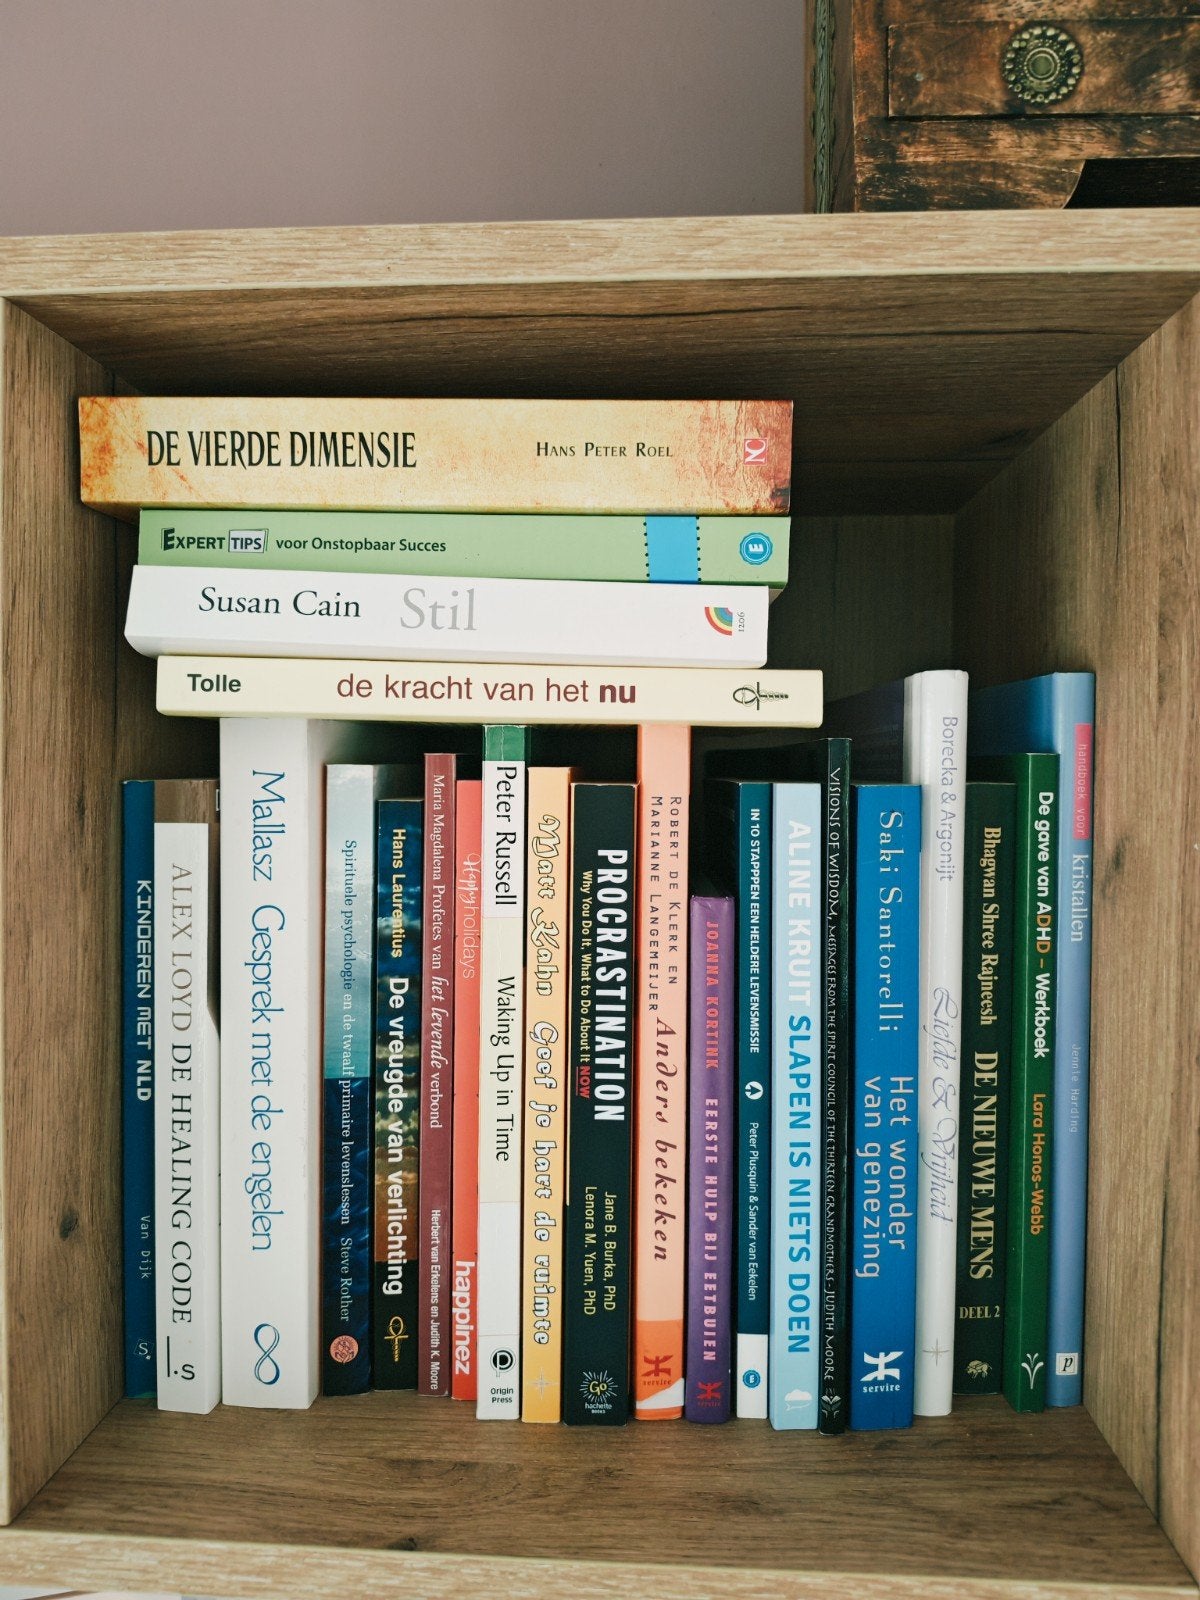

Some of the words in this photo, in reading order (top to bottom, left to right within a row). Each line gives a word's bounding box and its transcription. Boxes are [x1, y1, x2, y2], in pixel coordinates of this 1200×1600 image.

[146, 430, 181, 467] DE
[187, 430, 281, 470] VIERDE
[289, 431, 418, 469] DIMENSIE
[162, 527, 225, 552] EXPERT
[230, 535, 262, 551] TIPS
[275, 538, 308, 550] voor
[311, 536, 396, 554] Onstopbaar
[399, 538, 447, 552] Succes
[198, 586, 281, 615] Susan
[292, 590, 361, 618] Cain
[400, 587, 478, 632] Stil
[186, 673, 242, 693] Tolle
[336, 673, 373, 698] de
[384, 673, 473, 700] kracht
[482, 680, 535, 702] van
[545, 677, 589, 703] het
[599, 684, 636, 704] nu
[940, 716, 959, 786] Borecka
[432, 774, 445, 810] Maria
[495, 765, 518, 823] Peter
[828, 767, 842, 828] VISIONS
[941, 791, 957, 805] &
[1038, 791, 1054, 816] De
[252, 769, 286, 882] Mallasz
[750, 808, 761, 822] IN
[750, 823, 761, 838] 10
[392, 828, 407, 869] Hans
[430, 813, 445, 880] Magdalena
[531, 814, 561, 900] Matt
[829, 831, 840, 849] OF
[878, 810, 904, 873] Saki
[935, 809, 956, 882] Argonijt
[980, 826, 1002, 898] Bhagwan
[1034, 819, 1051, 862] gave
[343, 839, 358, 907] Spirituele
[494, 831, 517, 906] Russell
[581, 870, 594, 894] Why
[749, 839, 761, 900] STAPPPEN
[788, 820, 811, 909] ALINE
[826, 852, 841, 921] WISDOM,
[1037, 865, 1050, 897] van
[172, 863, 193, 940] ALEX
[391, 873, 406, 958] Laurentius
[432, 884, 445, 941] Profetes
[580, 896, 593, 917] You
[749, 902, 760, 924] EEN
[1070, 853, 1088, 942] kristallen
[137, 880, 152, 999] KINDEREN
[580, 920, 593, 936] Do
[580, 937, 593, 950] It,
[982, 902, 1000, 949] Shree
[1036, 901, 1052, 954] ADHD
[244, 904, 285, 1024] Gesprek
[340, 909, 356, 990] psychologie
[431, 944, 442, 970] van
[530, 907, 560, 997] Kahn
[580, 952, 592, 982] What
[705, 921, 719, 987] JOANNA
[749, 925, 760, 974] HELDERE
[787, 919, 811, 1007] KRUIT
[878, 886, 904, 1034] Santorelli
[171, 951, 193, 1032] LOYD
[343, 993, 352, 1010] en
[388, 977, 409, 1009] De
[431, 975, 449, 1001] het
[580, 983, 592, 997] to
[580, 999, 592, 1015] Do
[593, 849, 629, 1122] PROCRASTINATION
[976, 953, 999, 1026] Rajneesh
[137, 1007, 151, 1050] MET
[342, 1013, 355, 1031] de
[490, 975, 516, 1047] Waking
[705, 996, 719, 1069] KORTINK
[749, 976, 760, 1054] LEVENSMISSIE
[1033, 972, 1051, 1059] Werkboek
[342, 1034, 356, 1078] twaalf
[427, 1007, 446, 1068] levende
[530, 1021, 562, 1090] Geef
[579, 1017, 592, 1052] About
[172, 1043, 193, 1082] DE
[252, 1032, 274, 1086] met
[382, 1015, 406, 1114] vreugde
[490, 1054, 515, 1083] Up
[579, 1053, 592, 1063] It
[655, 1016, 679, 1124] Anders
[789, 1014, 812, 1129] SLAPEN
[975, 1050, 1001, 1088] DE
[136, 1059, 152, 1102] NLD
[430, 1072, 442, 1129] verbond
[496, 1089, 514, 1107] in
[864, 1075, 883, 1128] van
[889, 1075, 914, 1127] Het
[251, 1094, 284, 1131] de
[339, 1079, 354, 1138] primaire
[529, 1100, 557, 1128] je
[1032, 1093, 1047, 1128] Lara
[387, 1120, 405, 1163] van
[495, 1114, 513, 1162] Time
[704, 1098, 719, 1165] EERSTE
[749, 1122, 760, 1150] Peter
[971, 1094, 998, 1198] NIEUWE
[171, 1092, 193, 1230] HEALING
[532, 1140, 558, 1199] hart
[746, 1151, 760, 1194] Plusquin
[788, 1141, 811, 1168] IS
[244, 1142, 284, 1251] engelen
[340, 1140, 354, 1225] levenslessen
[653, 1139, 678, 1262] bekeken
[704, 1175, 718, 1222] HULP
[748, 1195, 759, 1204] &
[888, 1138, 914, 1251] wonder
[1030, 1133, 1046, 1236] Honos-Webb
[140, 1214, 151, 1239] Van
[430, 1209, 441, 1244] Herbert
[534, 1210, 557, 1242] de
[583, 1185, 597, 1230] Lenora
[603, 1191, 617, 1222] Jane
[747, 1204, 759, 1240] Sander
[787, 1178, 811, 1262] NIETS
[854, 1142, 886, 1278] genezing
[382, 1169, 408, 1296] verlichting
[584, 1232, 597, 1249] M.
[603, 1224, 617, 1238] B.
[704, 1232, 718, 1262] BIJ
[747, 1241, 756, 1261] van
[968, 1204, 996, 1280] MENS
[139, 1250, 151, 1279] Dijk
[340, 1237, 353, 1274] Steve
[430, 1245, 439, 1263] van
[582, 1251, 597, 1287] Yuen,
[602, 1240, 617, 1282] Burka,
[171, 1240, 193, 1324] CODE
[340, 1277, 353, 1322] Rother
[430, 1264, 441, 1304] Erkelens
[533, 1254, 557, 1345] ruimte
[583, 1290, 597, 1316] PhD
[603, 1285, 617, 1311] PhD
[747, 1262, 759, 1301] Eekelen
[430, 1305, 439, 1318] en
[452, 1260, 475, 1375] happinez
[703, 1271, 718, 1361] EETBUIEN
[787, 1273, 810, 1354] DOEN
[823, 1288, 836, 1330] JUDITH
[959, 1306, 992, 1319] DEEL
[994, 1305, 1001, 1318] 2
[429, 1319, 440, 1348] Judith
[430, 1349, 440, 1360] K.
[429, 1361, 440, 1390] Moore
[823, 1334, 835, 1381] MOORE
[862, 1383, 901, 1393] servire
